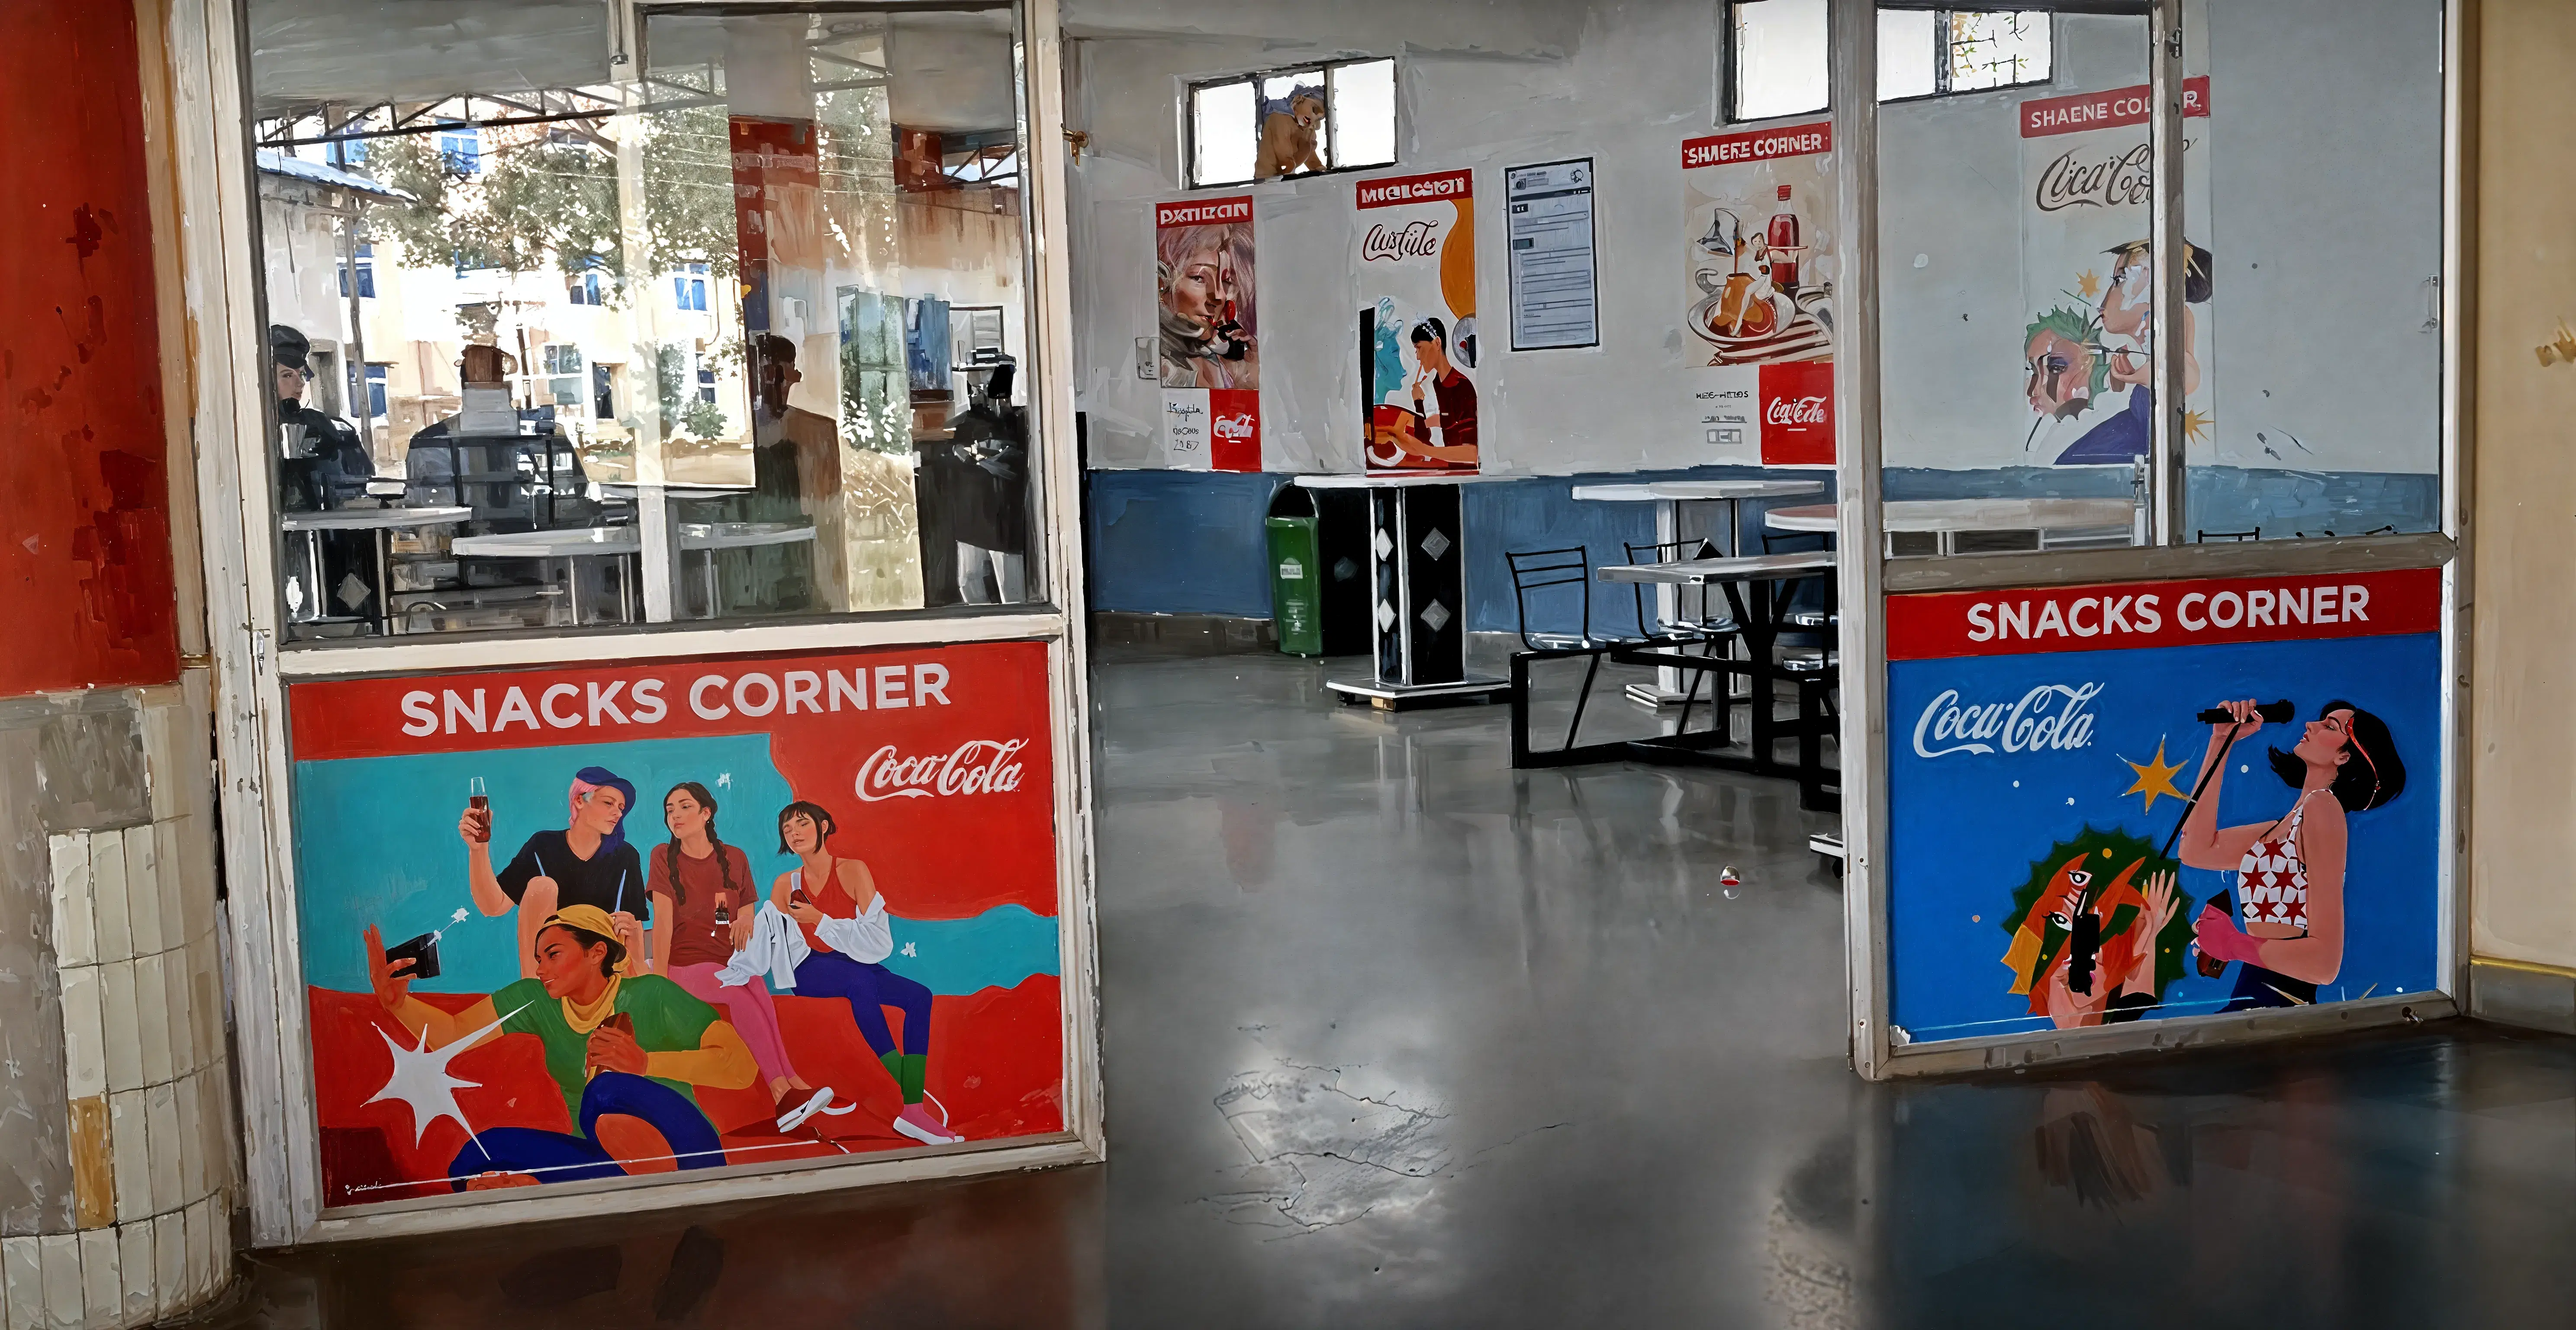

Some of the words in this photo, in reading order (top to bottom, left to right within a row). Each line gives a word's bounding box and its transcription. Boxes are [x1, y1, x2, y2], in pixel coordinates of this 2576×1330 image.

[1967, 594, 2161, 642] SNACKS
[2177, 585, 2369, 631] CORNER
[401, 680, 667, 736] SNACKS
[689, 663, 951, 720] CORNER
